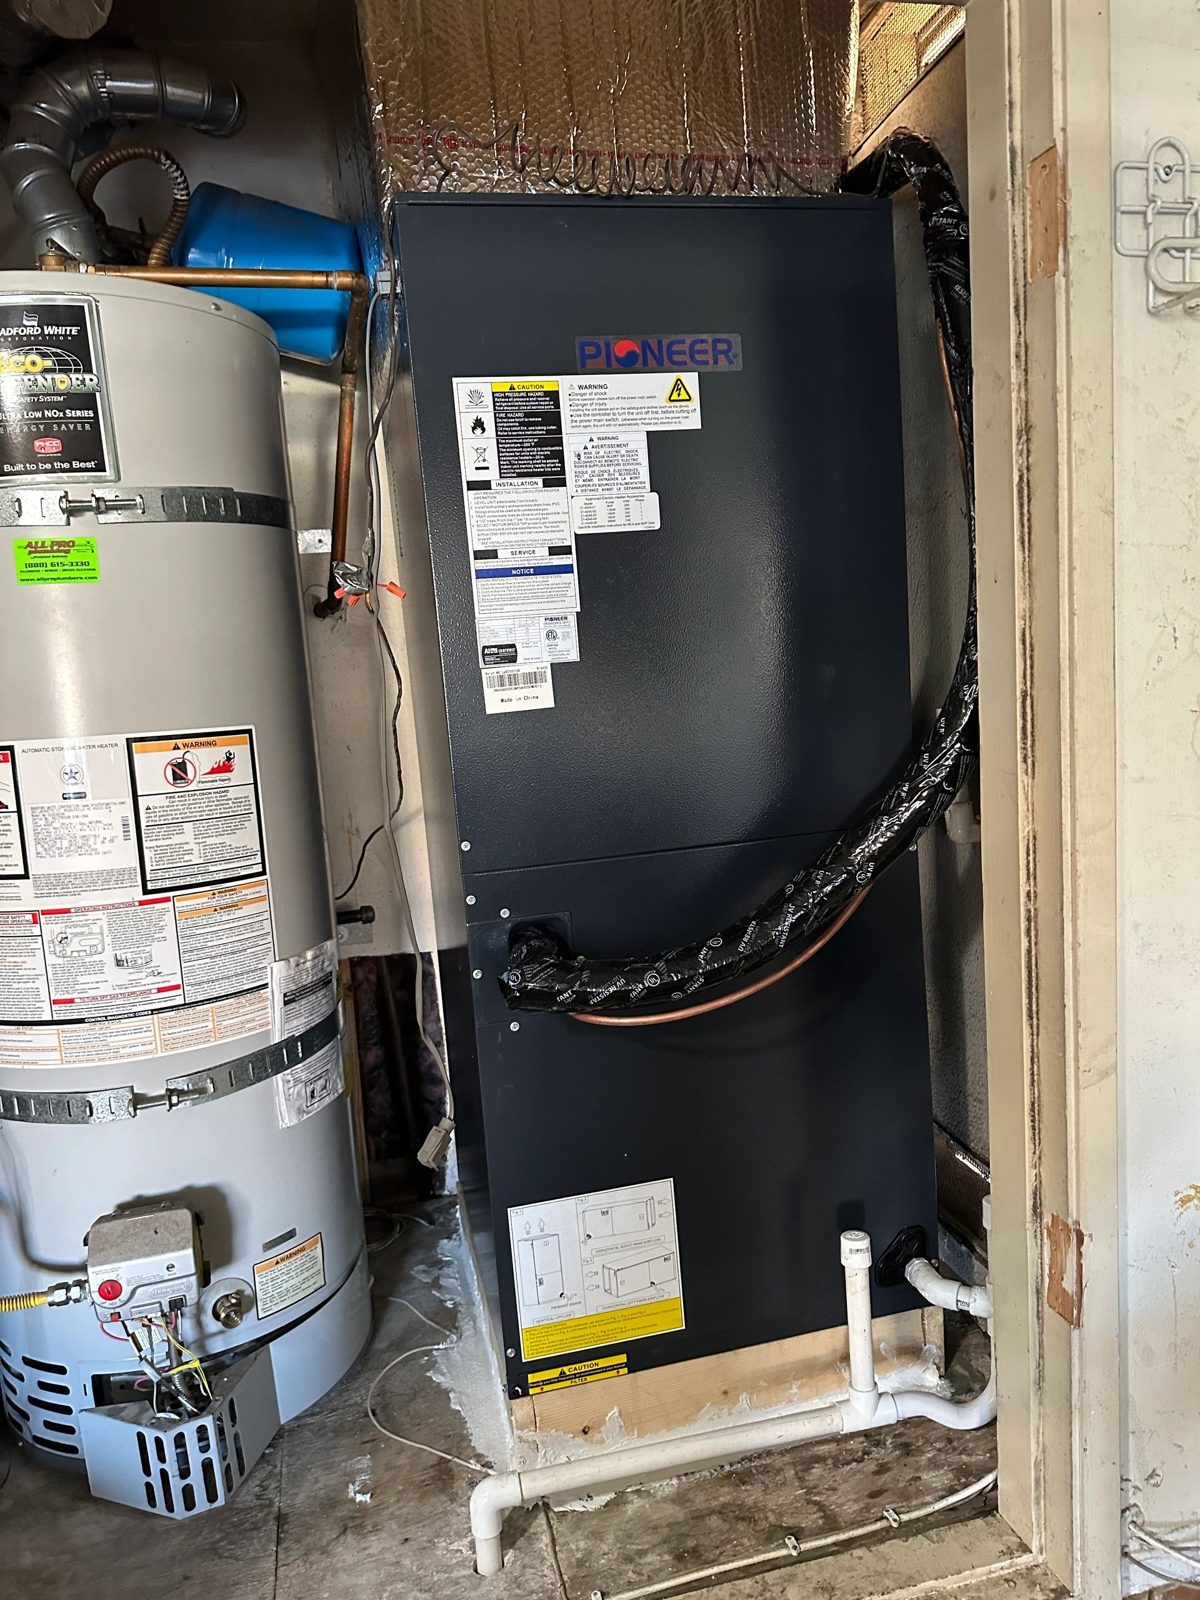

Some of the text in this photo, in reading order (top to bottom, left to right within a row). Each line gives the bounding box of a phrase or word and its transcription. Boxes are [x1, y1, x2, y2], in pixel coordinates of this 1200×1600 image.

[44, 325, 78, 335] WHITE
[577, 338, 736, 373] PIONEER
[66, 409, 94, 418] SERIES
[53, 424, 92, 432] SAVER
[4, 465, 25, 473] Built
[39, 462, 52, 470] be
[54, 461, 70, 469] the
[73, 460, 96, 468] Best
[182, 740, 217, 749] WARNING
[22, 747, 50, 755] AUTOMATIC
[219, 903, 239, 911] WARNING
[280, 1245, 306, 1263] WARNING
[568, 1362, 600, 1373] CAUTION
[570, 1377, 588, 1385] FILTER
